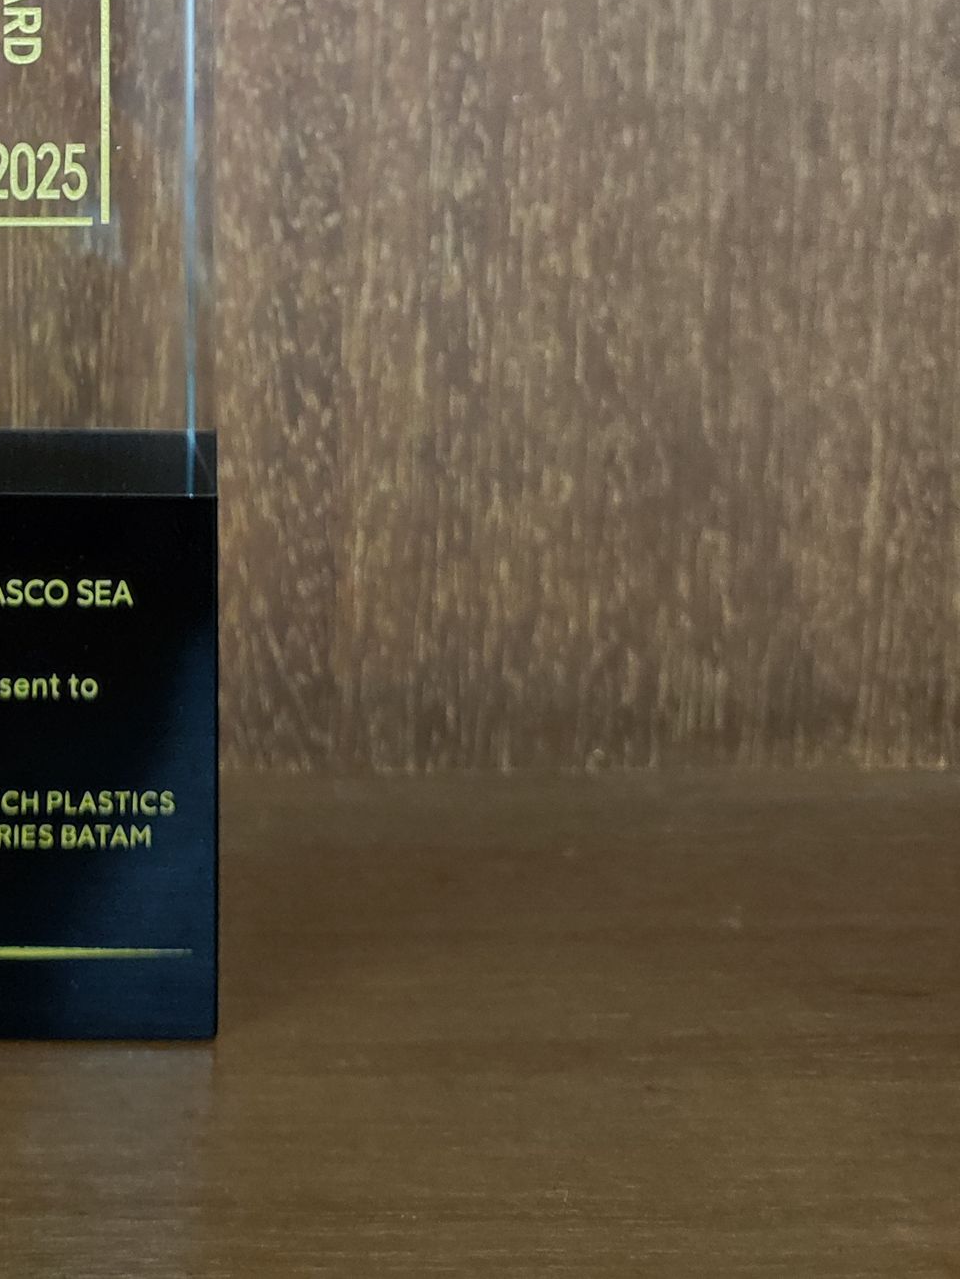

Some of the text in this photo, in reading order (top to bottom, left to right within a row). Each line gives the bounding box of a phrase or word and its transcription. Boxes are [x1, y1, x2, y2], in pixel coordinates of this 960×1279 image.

[76, 578, 134, 607] SEA
[69, 674, 99, 700] to
[46, 790, 177, 816] PLASTICS
[60, 823, 152, 850] BATAM
